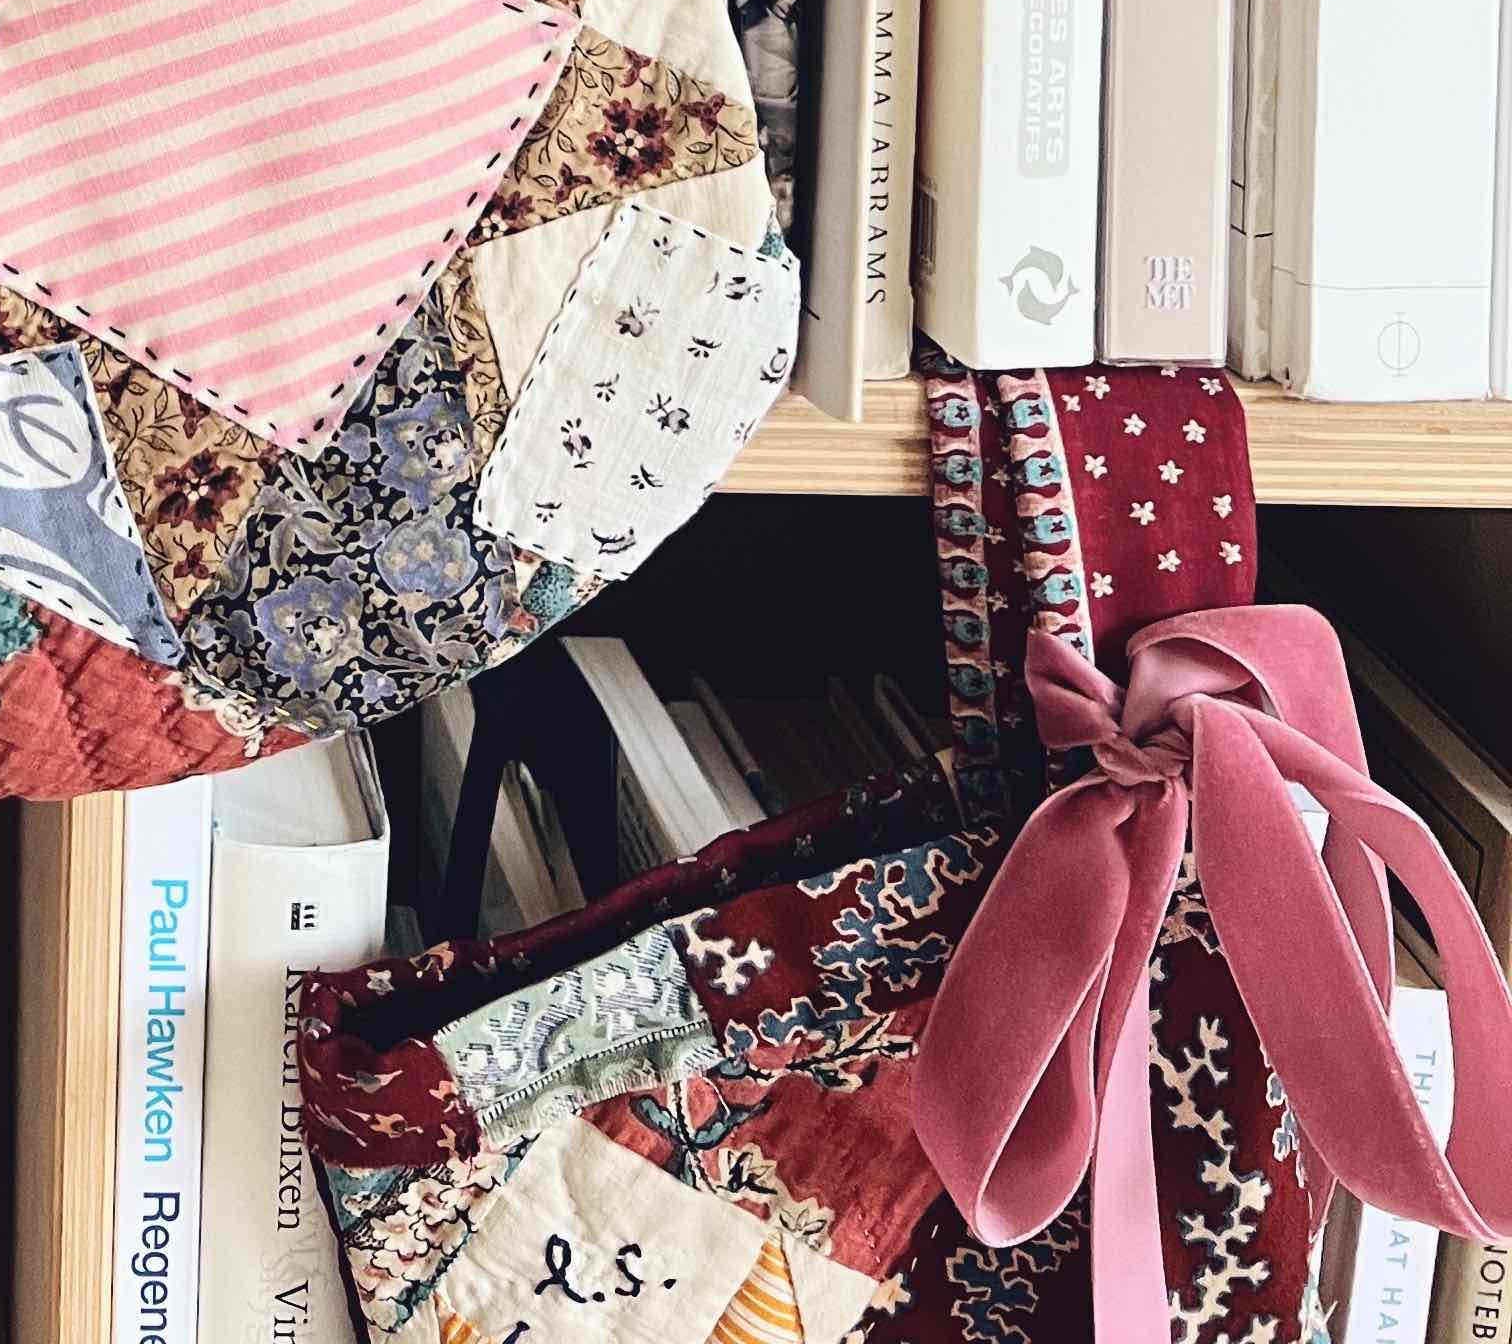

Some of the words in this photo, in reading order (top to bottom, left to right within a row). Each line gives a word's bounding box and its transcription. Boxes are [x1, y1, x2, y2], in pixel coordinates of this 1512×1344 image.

[1046, 58, 1066, 163] ARTS
[1144, 283, 1194, 310] MET
[148, 880, 189, 972] Paul
[144, 985, 186, 1163] Hawken
